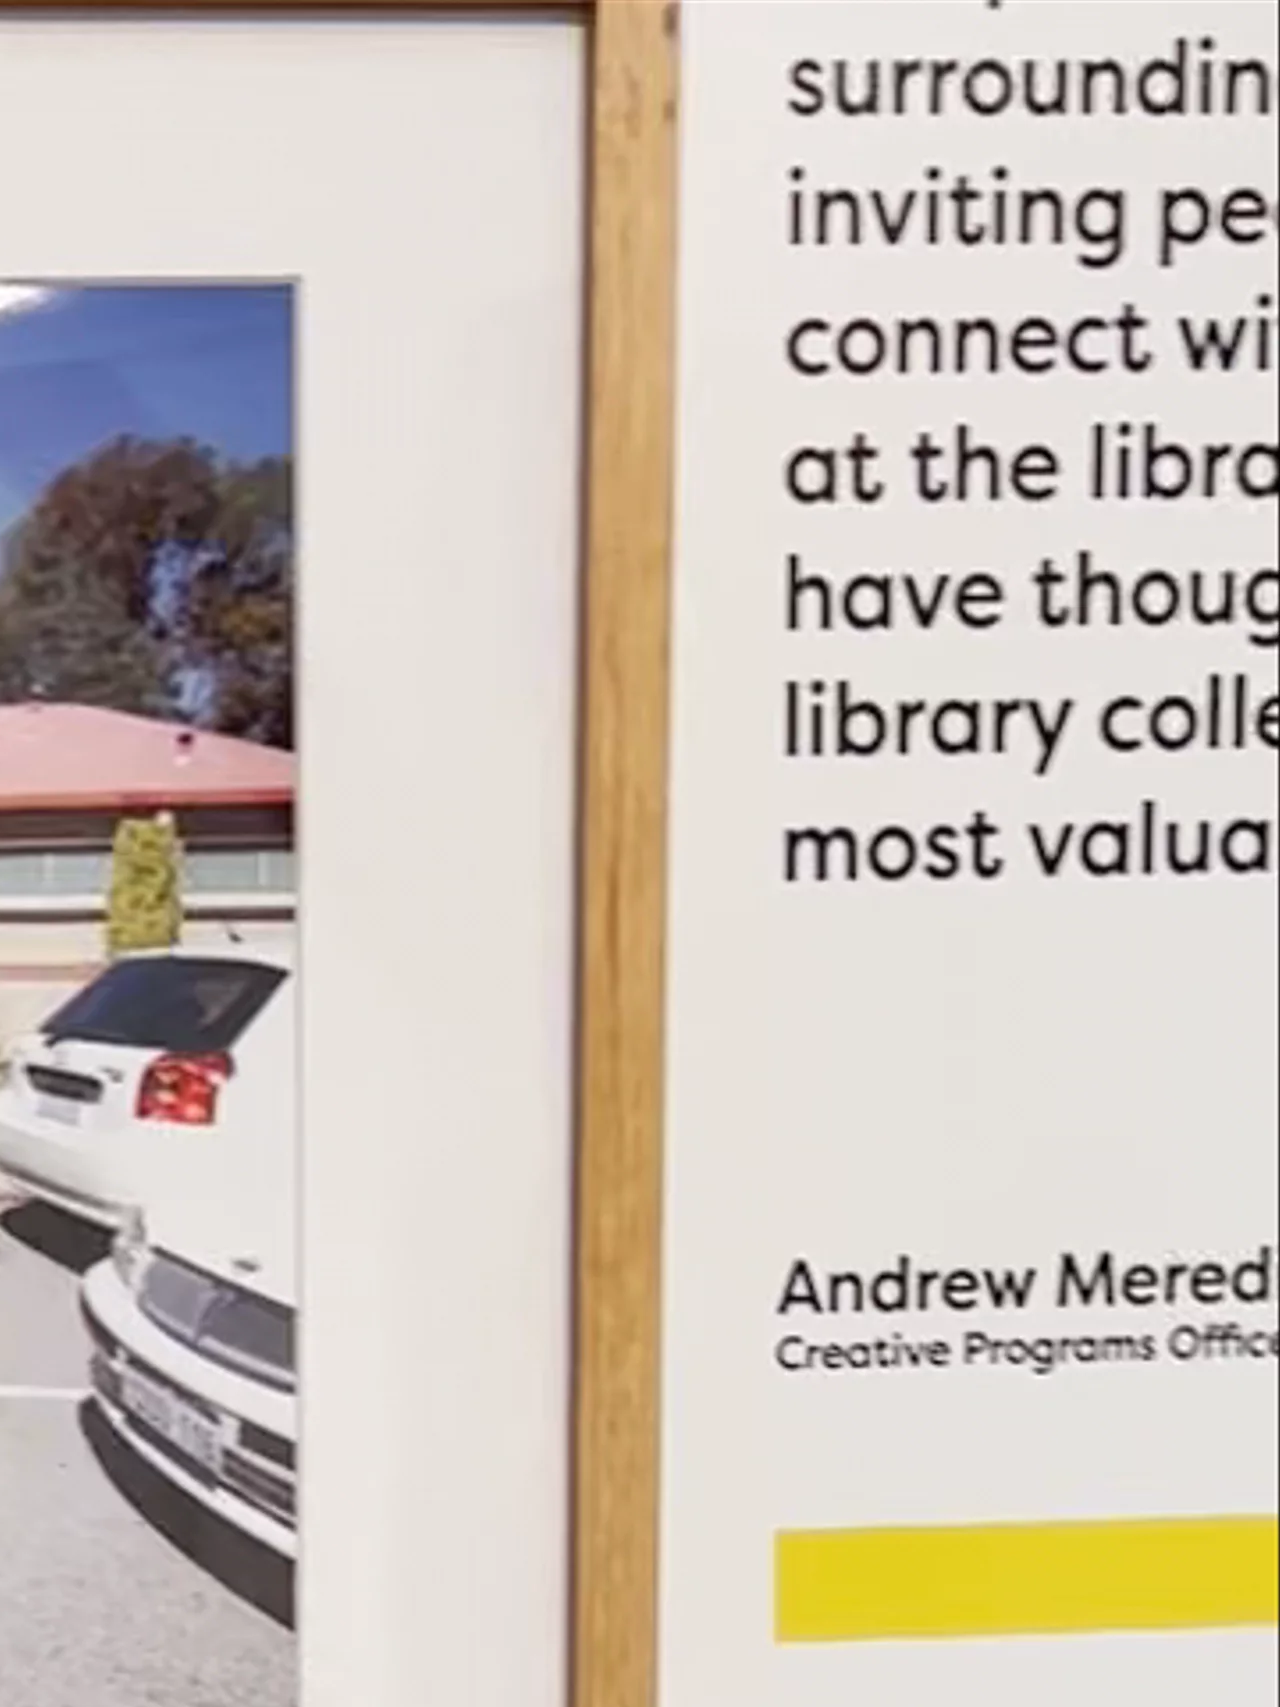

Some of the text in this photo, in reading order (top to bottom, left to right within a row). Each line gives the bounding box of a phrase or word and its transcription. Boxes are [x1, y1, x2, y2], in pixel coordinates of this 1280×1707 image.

[788, 36, 1271, 117] surroundin
[789, 166, 1279, 270] inviting pe
[785, 304, 1153, 376] connect
[785, 433, 885, 505] at
[909, 424, 1061, 503] the
[786, 550, 1279, 648] have thoug
[785, 680, 1075, 777] library
[784, 799, 1271, 882] most valua
[777, 1245, 1272, 1315] Andrew Mered
[775, 1332, 952, 1371] Creative
[964, 1331, 1157, 1375] Programs
